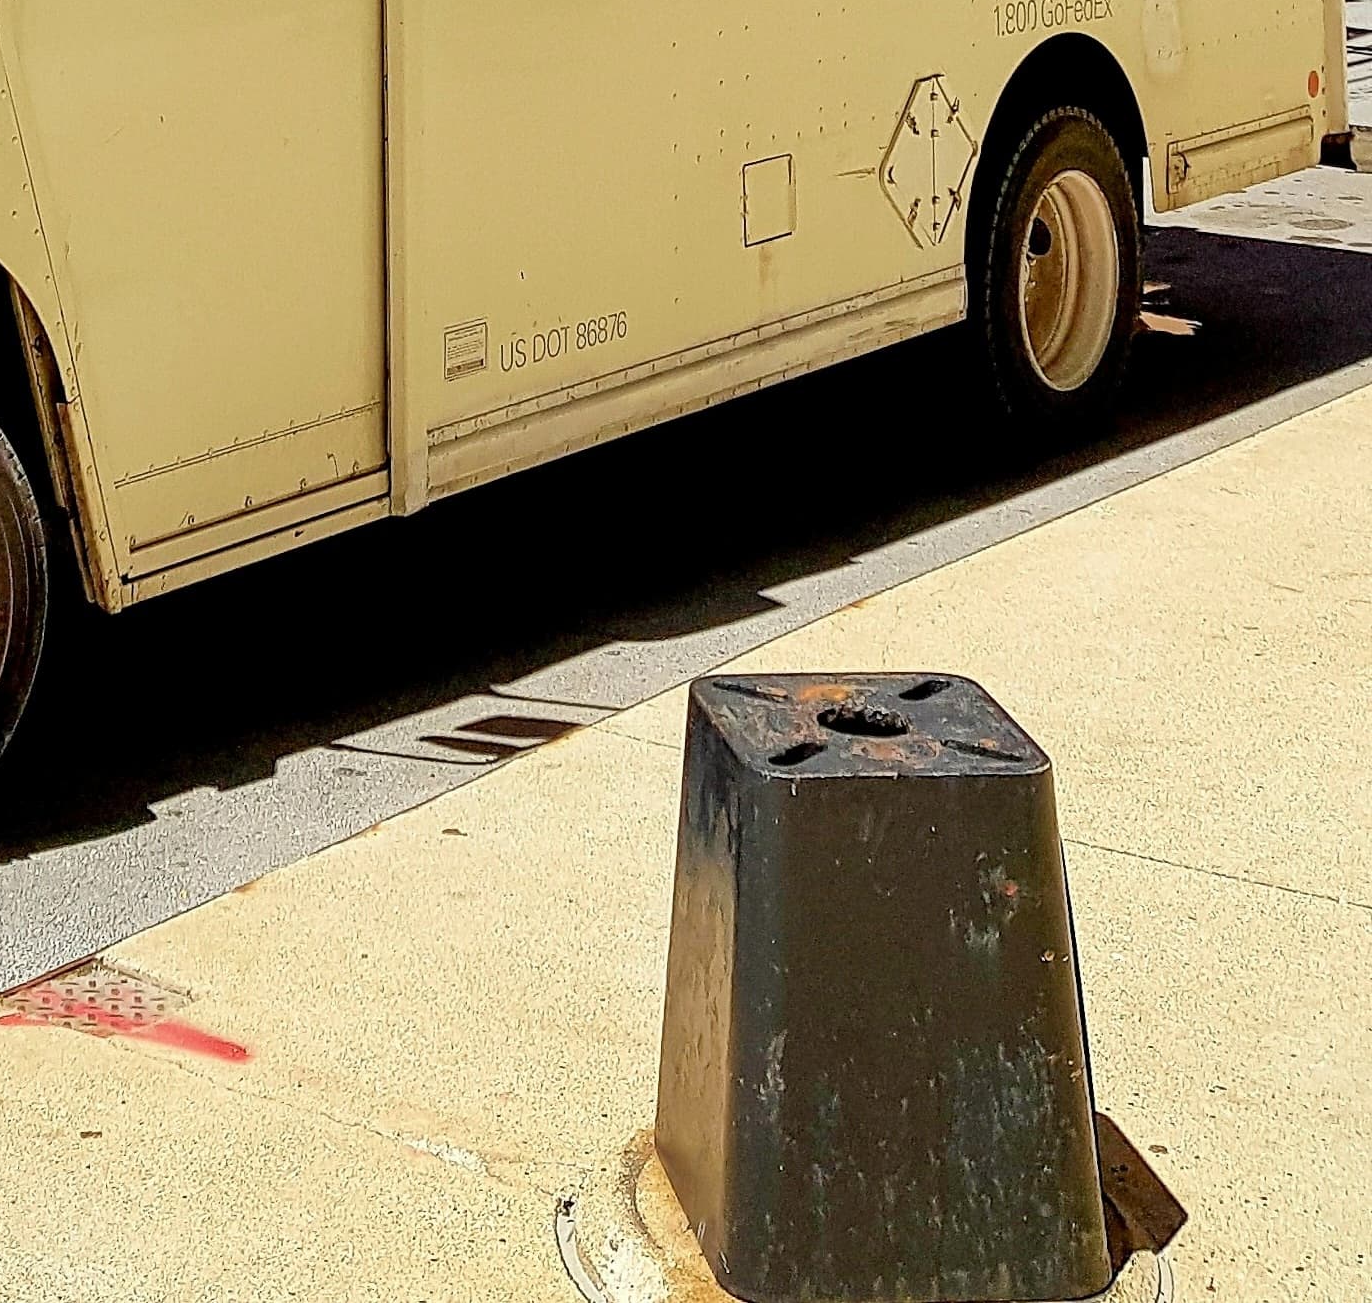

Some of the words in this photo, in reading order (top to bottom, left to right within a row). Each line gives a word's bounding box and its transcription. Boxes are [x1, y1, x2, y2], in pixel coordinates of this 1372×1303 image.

[500, 338, 526, 372] US
[532, 326, 571, 362] DOT
[576, 310, 627, 350] 86876
